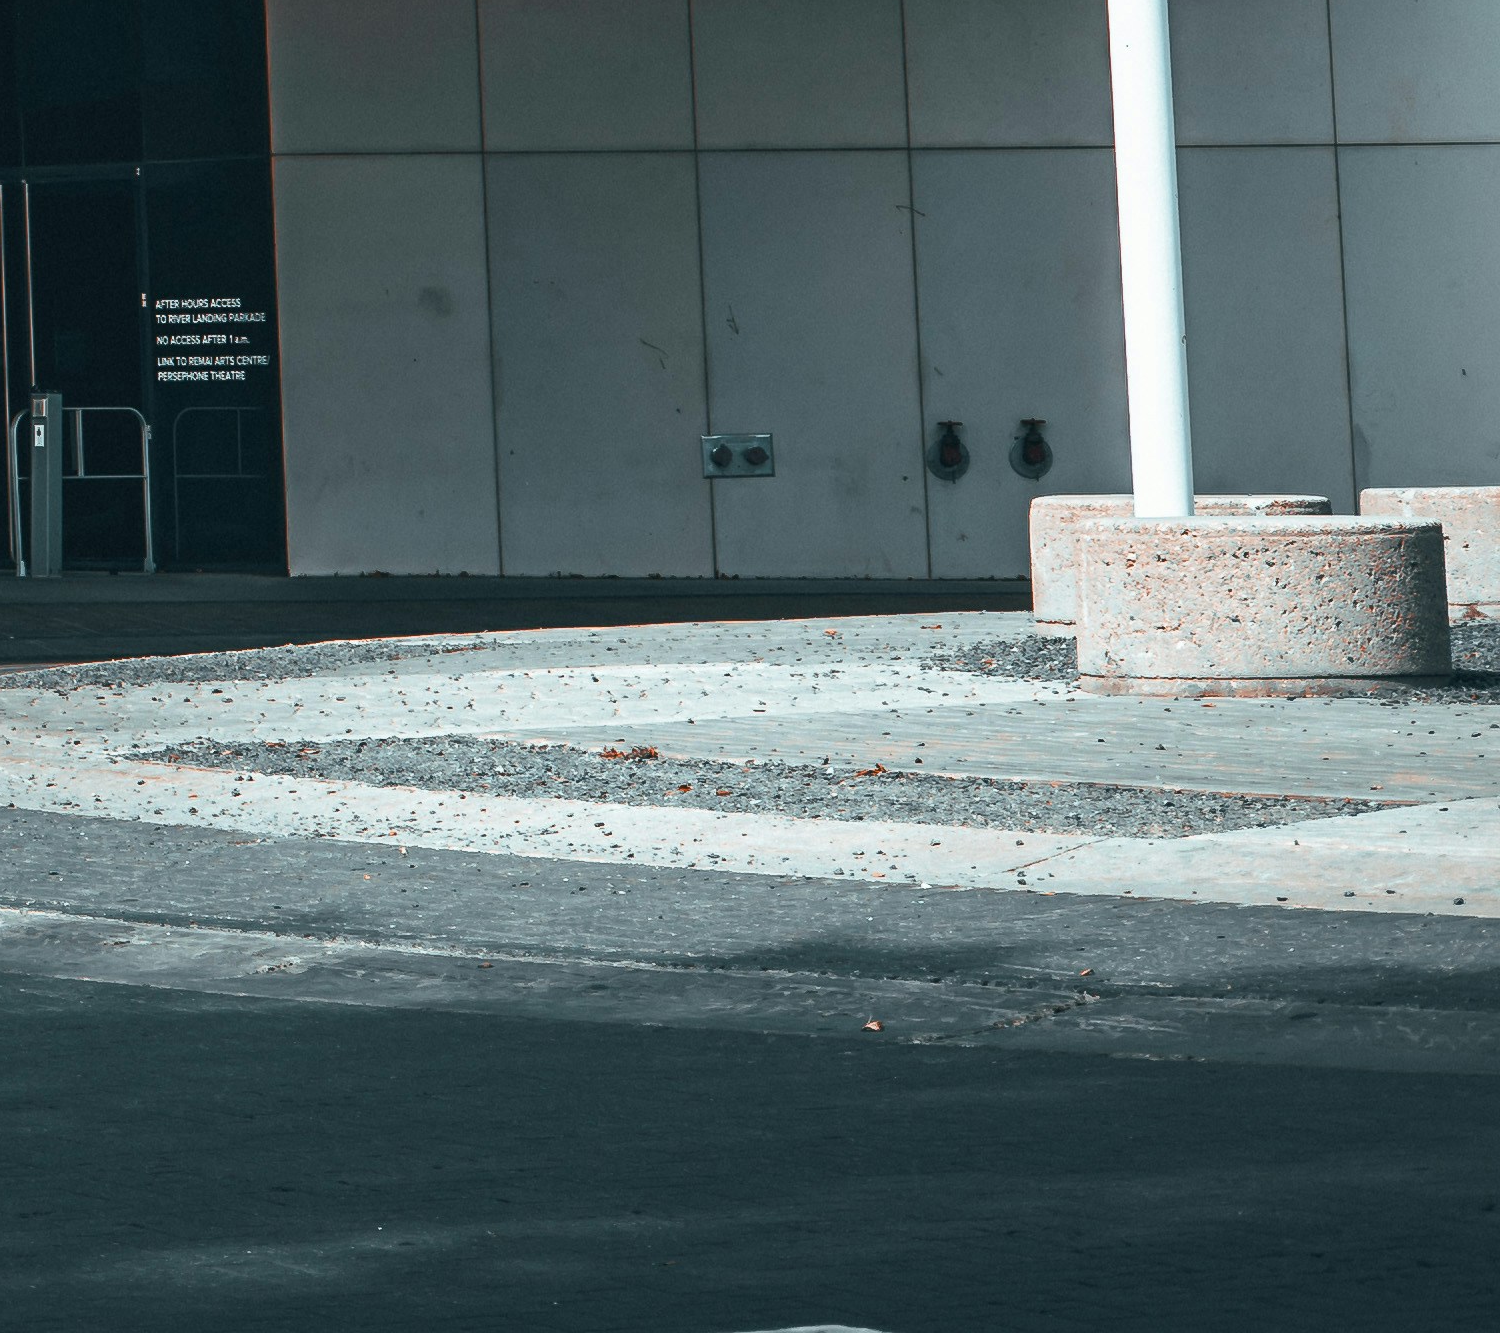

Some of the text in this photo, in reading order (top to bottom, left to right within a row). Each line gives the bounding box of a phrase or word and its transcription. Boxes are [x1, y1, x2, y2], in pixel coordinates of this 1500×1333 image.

[156, 298, 241, 309] AFTER HOURS ACCESS
[156, 312, 266, 324] TO RIVER LANDING PARKADE
[156, 336, 168, 345] NO
[170, 335, 200, 345] ACCESS
[202, 335, 226, 344] AFTER
[157, 357, 174, 366] LINK
[176, 357, 187, 366] TO
[188, 356, 213, 366] REMAI
[214, 356, 235, 365] ARTS
[158, 371, 246, 381] PERSEPHONE THEATRE
